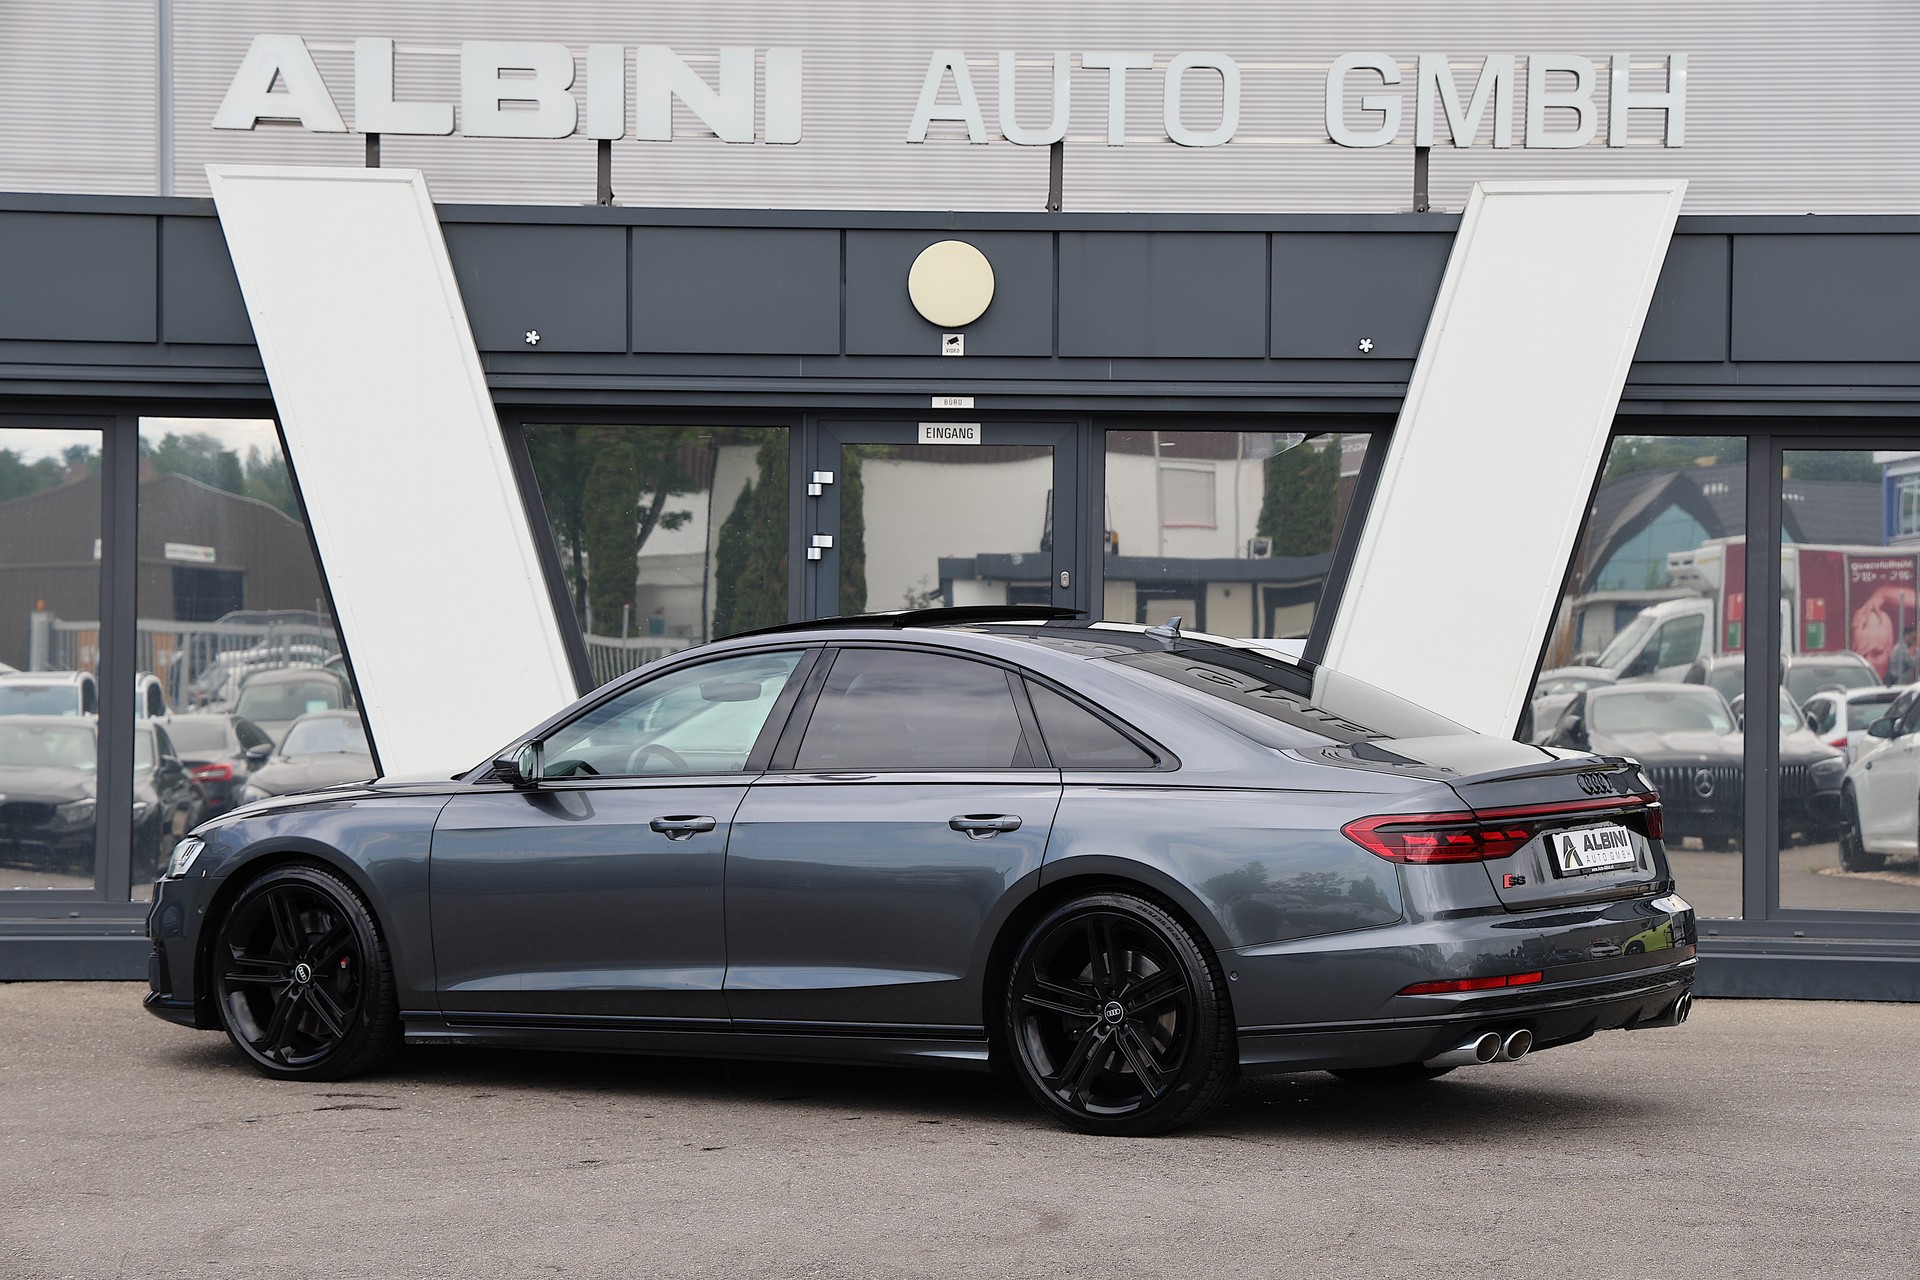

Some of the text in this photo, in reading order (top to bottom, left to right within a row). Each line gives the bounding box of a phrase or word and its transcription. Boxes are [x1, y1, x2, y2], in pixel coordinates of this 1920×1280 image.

[211, 34, 1688, 149] ALBINI AUTO GMBH
[943, 397, 963, 406] BÜRO
[926, 427, 974, 439] EINGANG
[1583, 830, 1628, 852] ALBINI
[1586, 853, 1608, 864] AUTO
